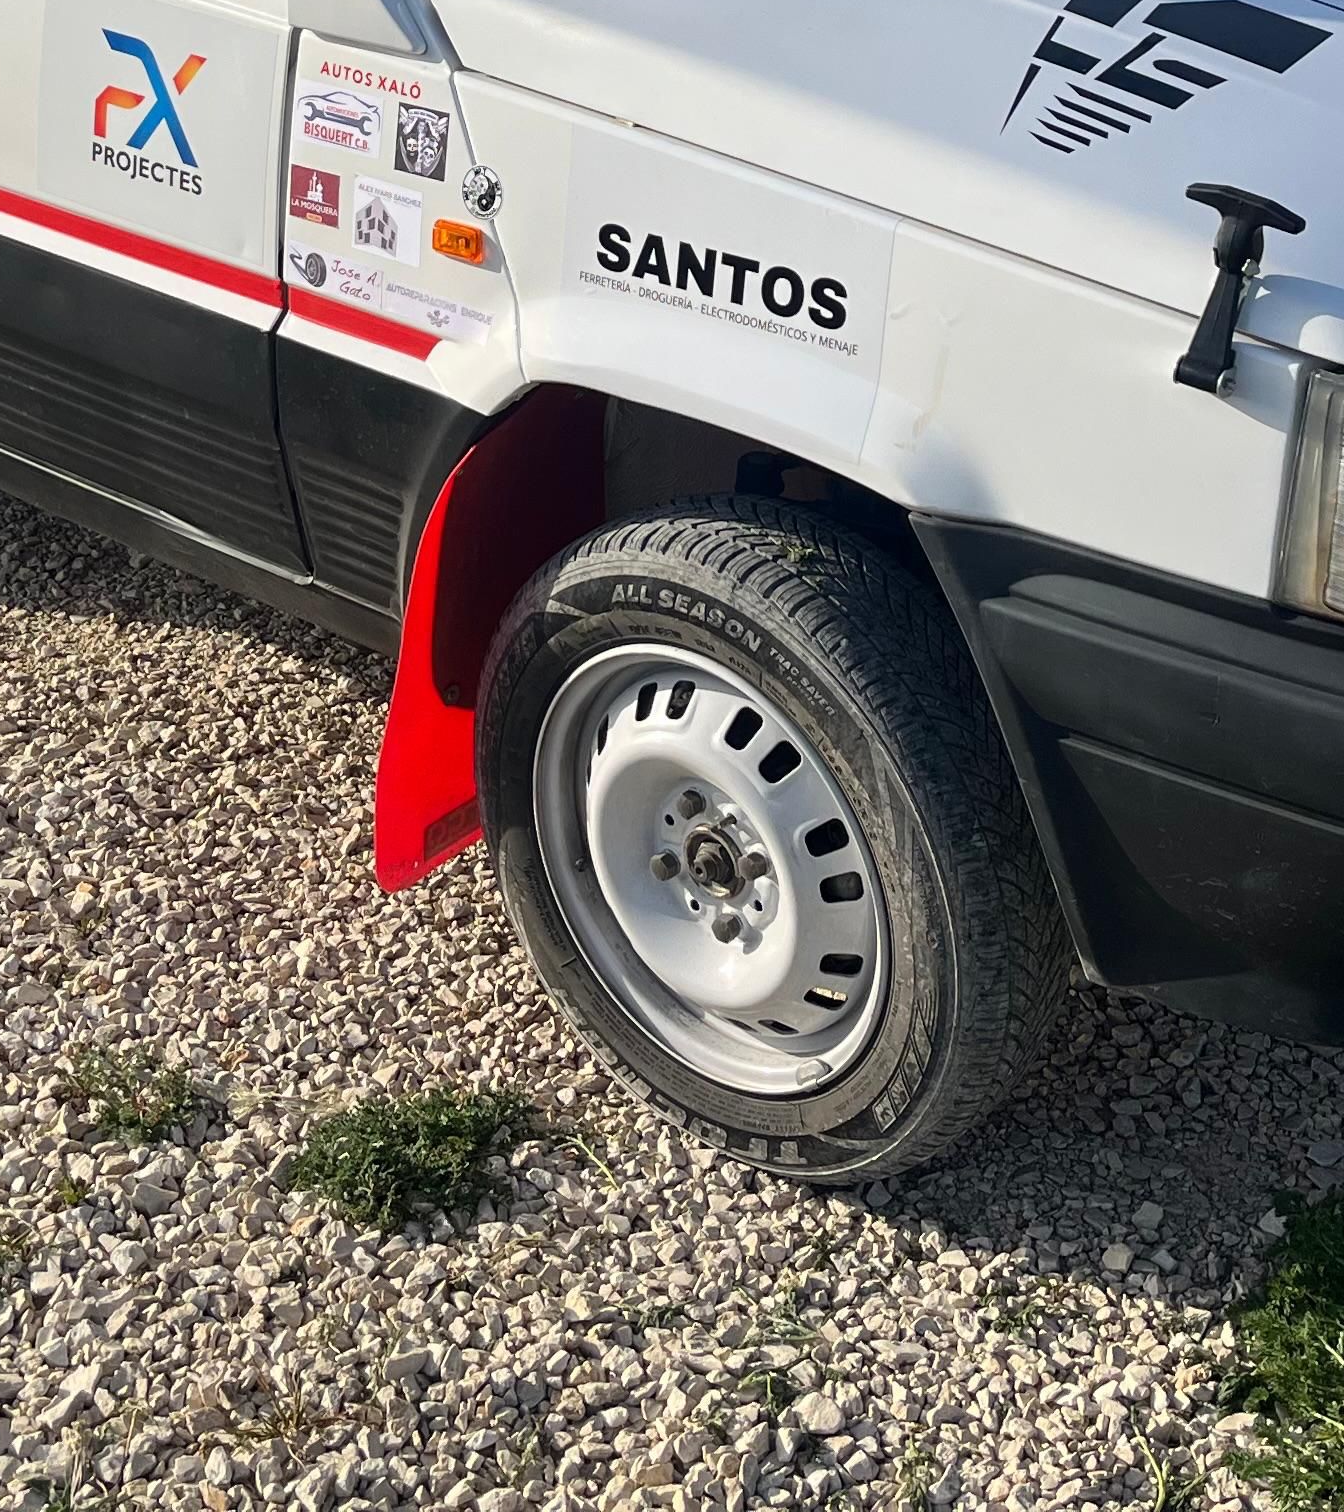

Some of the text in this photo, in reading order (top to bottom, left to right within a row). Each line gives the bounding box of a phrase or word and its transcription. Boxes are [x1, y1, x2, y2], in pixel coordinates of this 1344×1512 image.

[320, 60, 422, 100] AUTOS XALÓ
[303, 121, 354, 146] BISQUERT
[91, 142, 203, 196] PROJECTES
[291, 197, 300, 207] LA
[596, 222, 848, 330] SANTOS
[579, 270, 859, 357] FERRETERÍA DROGUERÍA ELECTRODOMÉSTICOS Y MENAJE
[611, 583, 653, 606] ALL
[657, 587, 763, 653] SEASON
[768, 646, 802, 678] TRAC
[799, 676, 837, 717] SAVER
